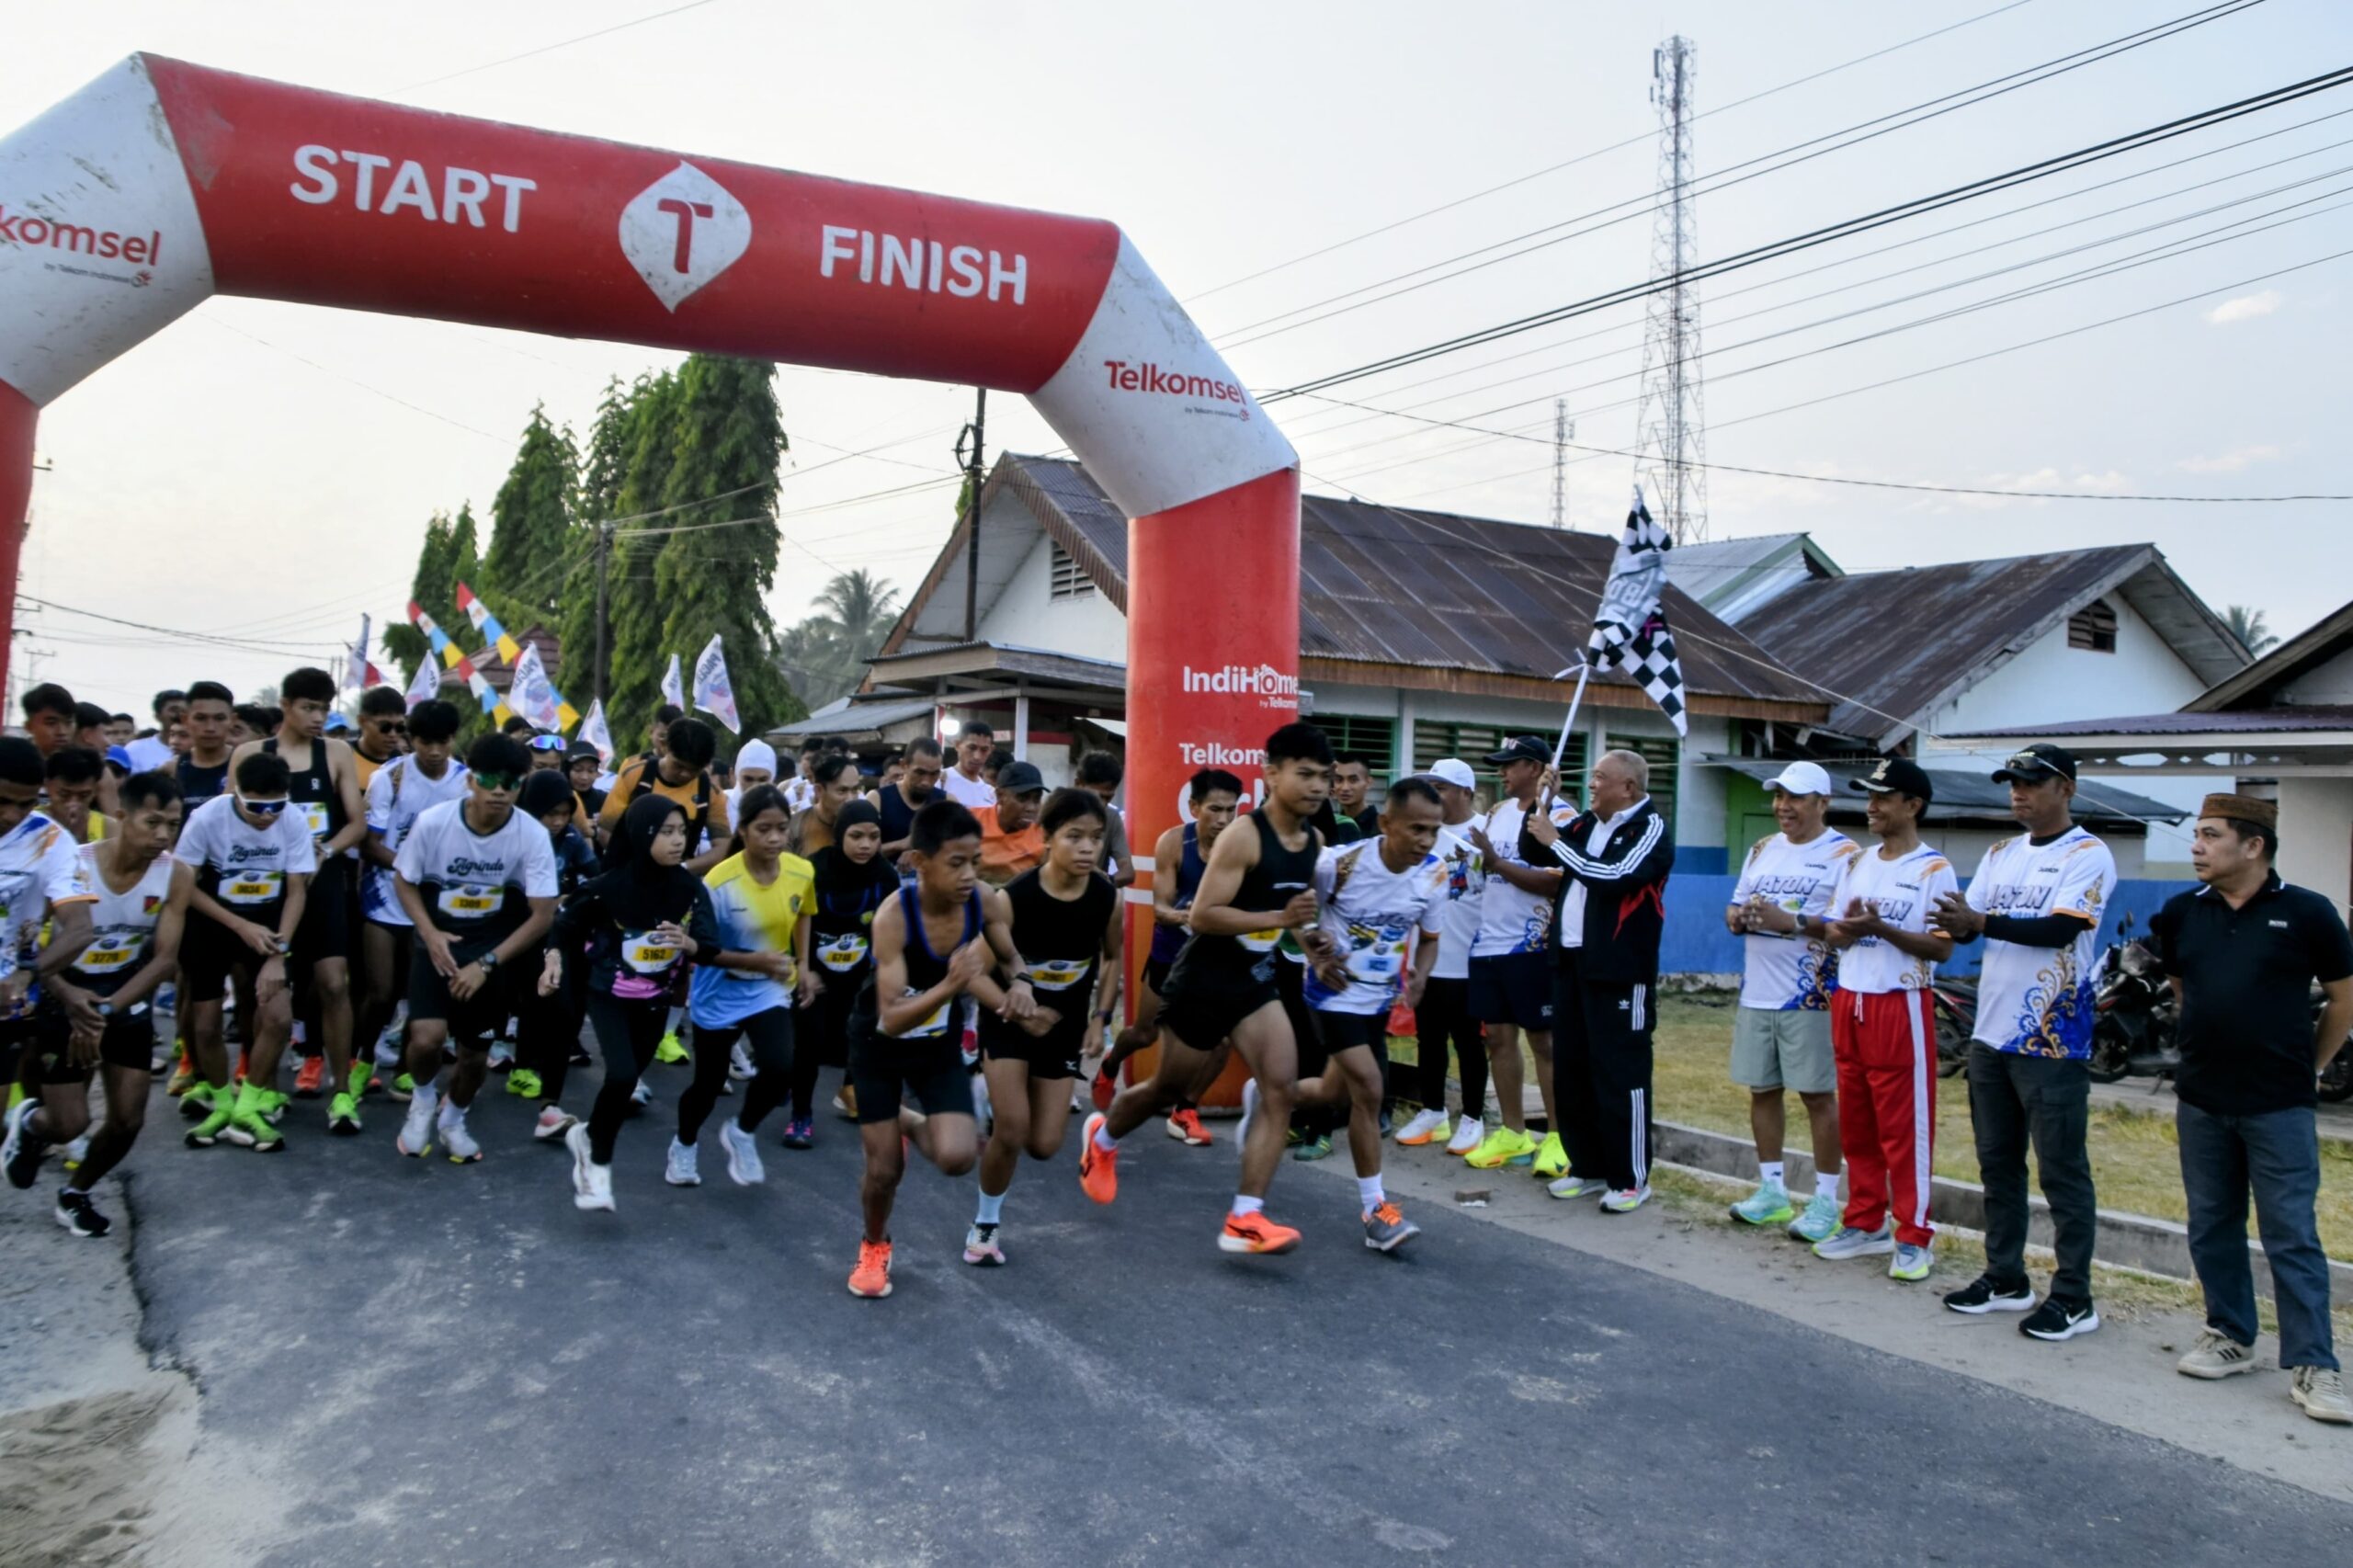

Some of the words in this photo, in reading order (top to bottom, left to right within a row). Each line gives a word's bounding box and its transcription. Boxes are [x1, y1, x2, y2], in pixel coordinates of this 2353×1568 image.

[290, 144, 537, 233] START
[0, 205, 161, 267] komsel
[820, 224, 1028, 305] FINISH
[1104, 360, 1247, 405] Telkomsel
[1178, 742, 1267, 765] Telkom
[642, 949, 666, 960] 5162
